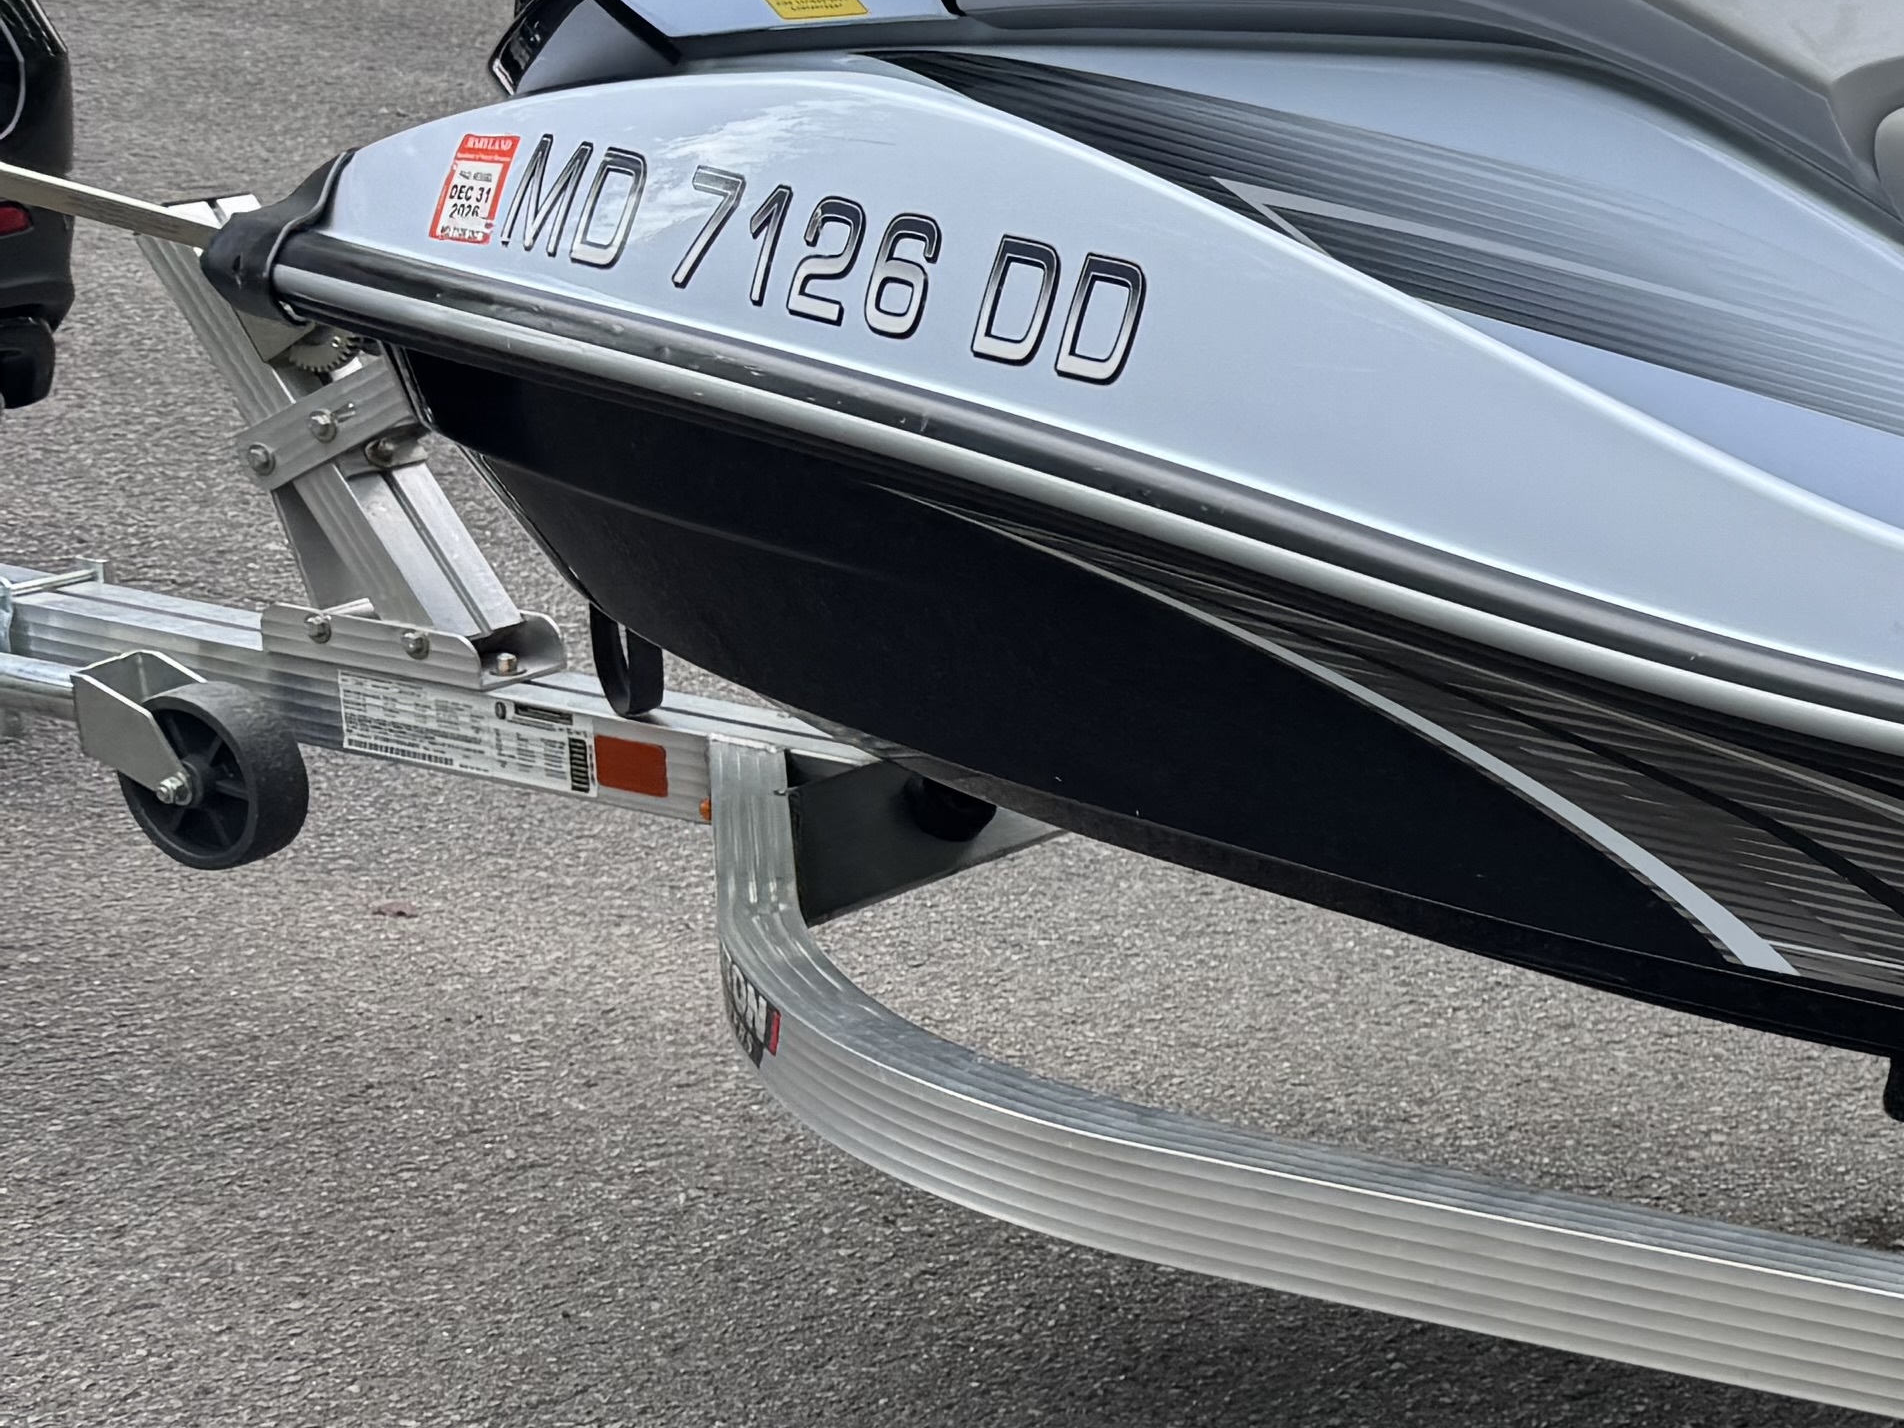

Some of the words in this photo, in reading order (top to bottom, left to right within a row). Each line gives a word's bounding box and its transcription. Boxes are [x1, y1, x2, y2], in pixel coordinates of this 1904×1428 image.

[449, 184, 474, 201] DEC
[475, 187, 491, 203] 31
[501, 133, 646, 269] MD
[672, 165, 942, 339] 7126
[971, 234, 1147, 384] DD
